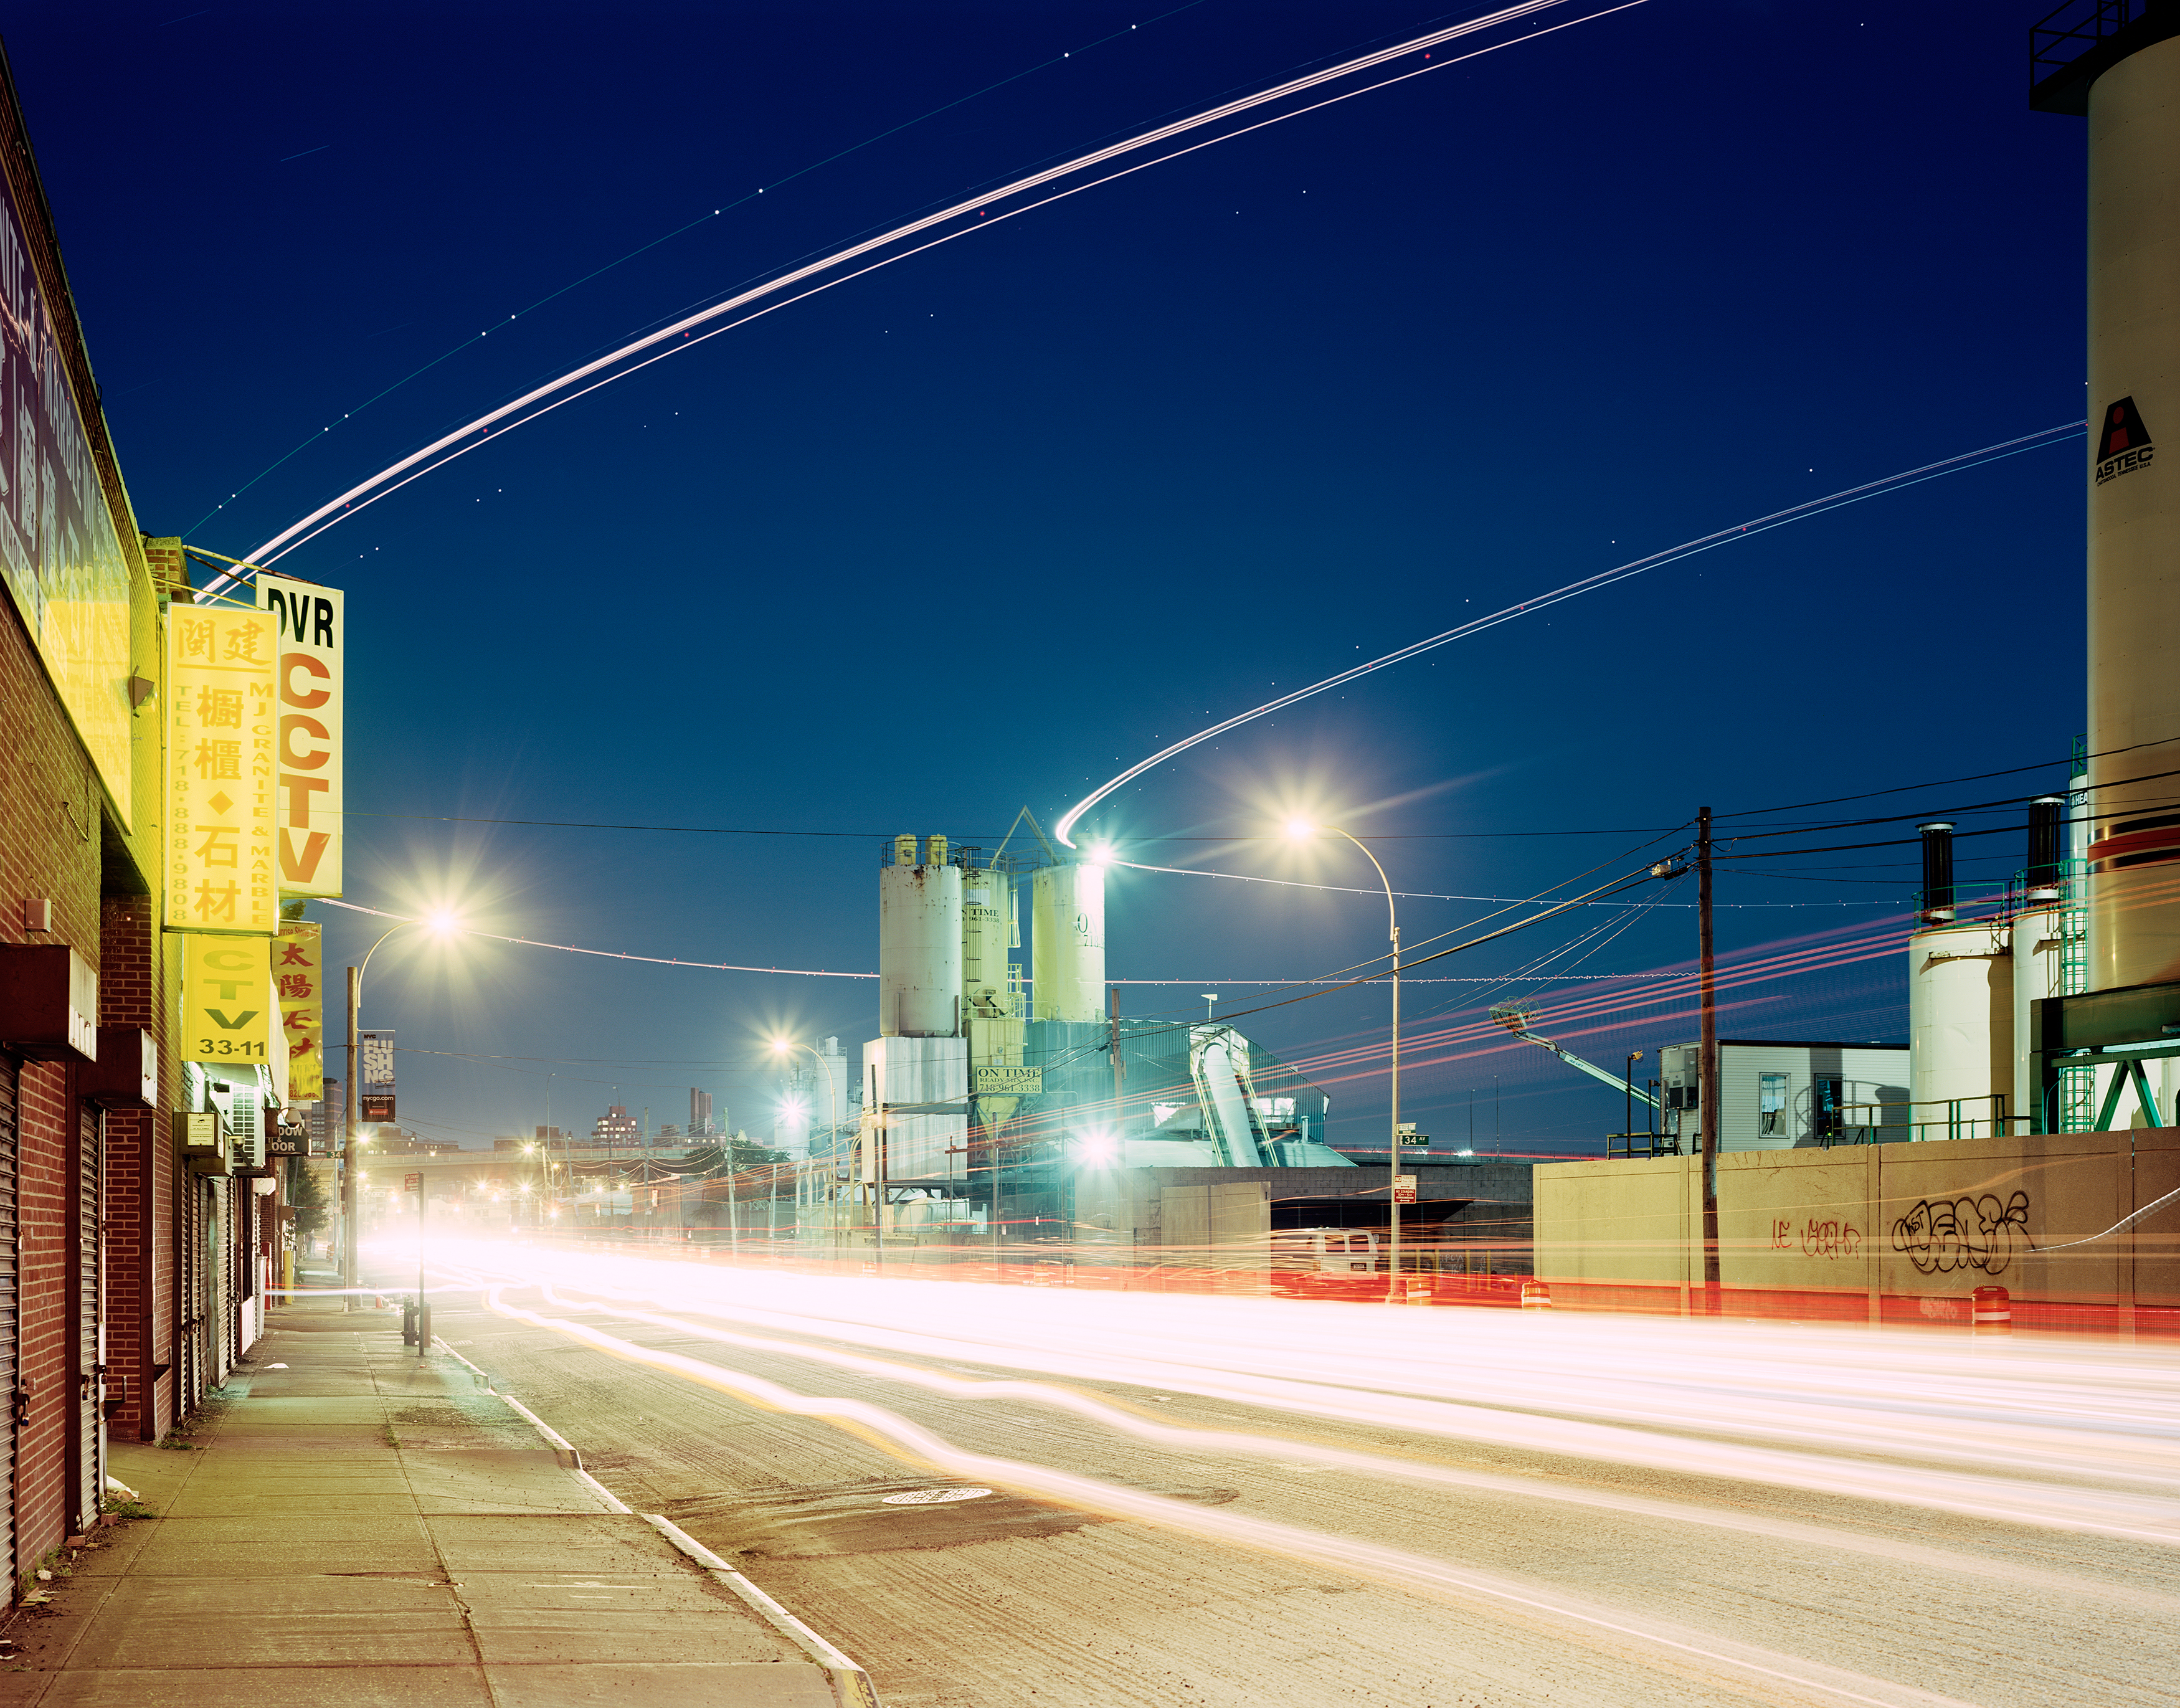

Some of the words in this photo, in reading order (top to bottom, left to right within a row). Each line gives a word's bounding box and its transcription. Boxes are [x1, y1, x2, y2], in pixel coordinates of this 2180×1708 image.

[44, 327, 81, 515] MARBLE
[2095, 446, 2154, 482] ASTEC
[268, 587, 334, 648] DVR
[251, 724, 272, 818] GRANITE
[279, 653, 331, 883] CCTV
[252, 825, 270, 837] &
[194, 825, 242, 923] 石材
[250, 845, 270, 925] MARBLE
[971, 909, 999, 917] TIME
[295, 926, 310, 937] Stone
[203, 934, 260, 1030] CTV
[199, 1038, 265, 1057] 33-11
[364, 1040, 393, 1054] FLU
[364, 1070, 394, 1084] NG
[979, 1068, 999, 1077] ON
[1003, 1068, 1040, 1078] TIME
[980, 1084, 1040, 1092] 718-961-3338
[1405, 1136, 1417, 1144] 34
